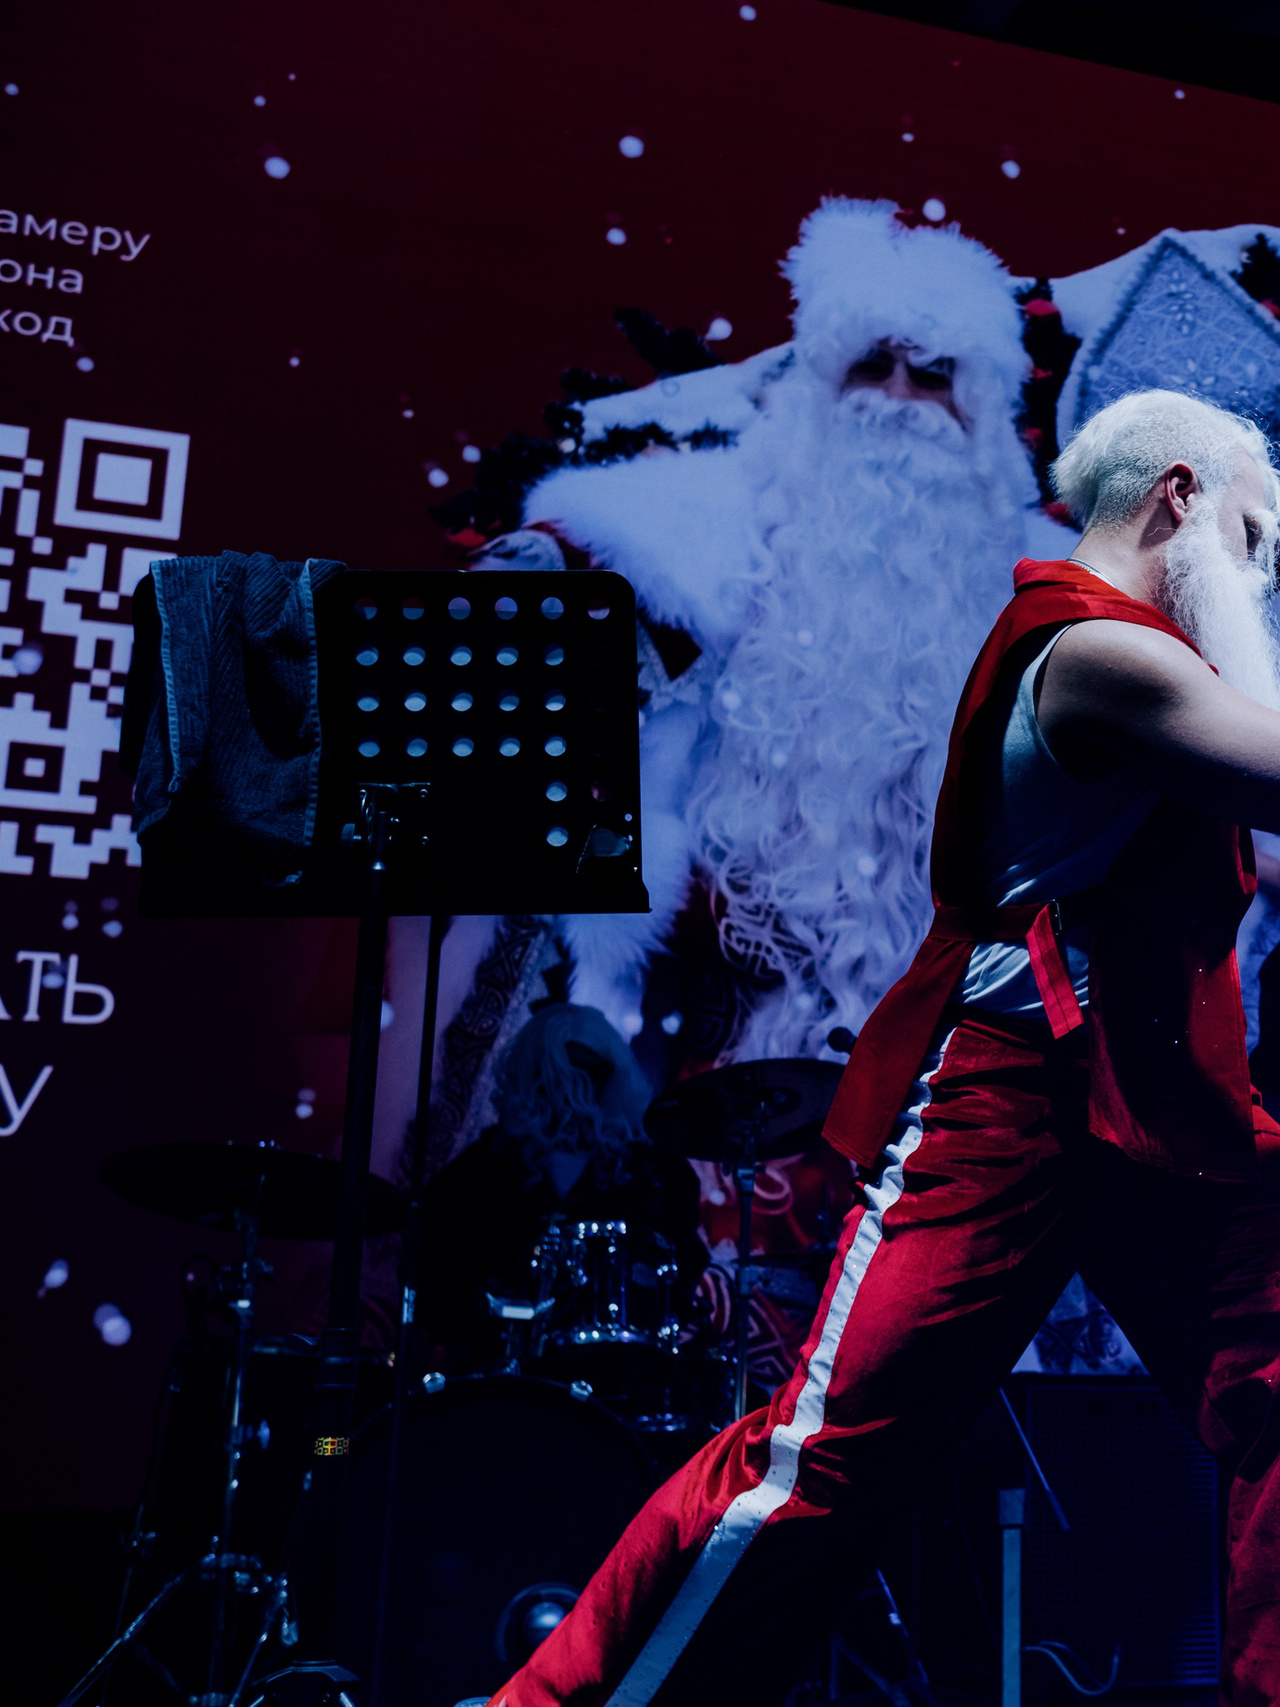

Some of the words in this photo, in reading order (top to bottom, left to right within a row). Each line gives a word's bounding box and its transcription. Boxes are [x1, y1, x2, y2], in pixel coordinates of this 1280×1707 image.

[0, 209, 151, 262] амеру
[0, 258, 84, 294] она
[0, 950, 115, 1025] ТЬ
